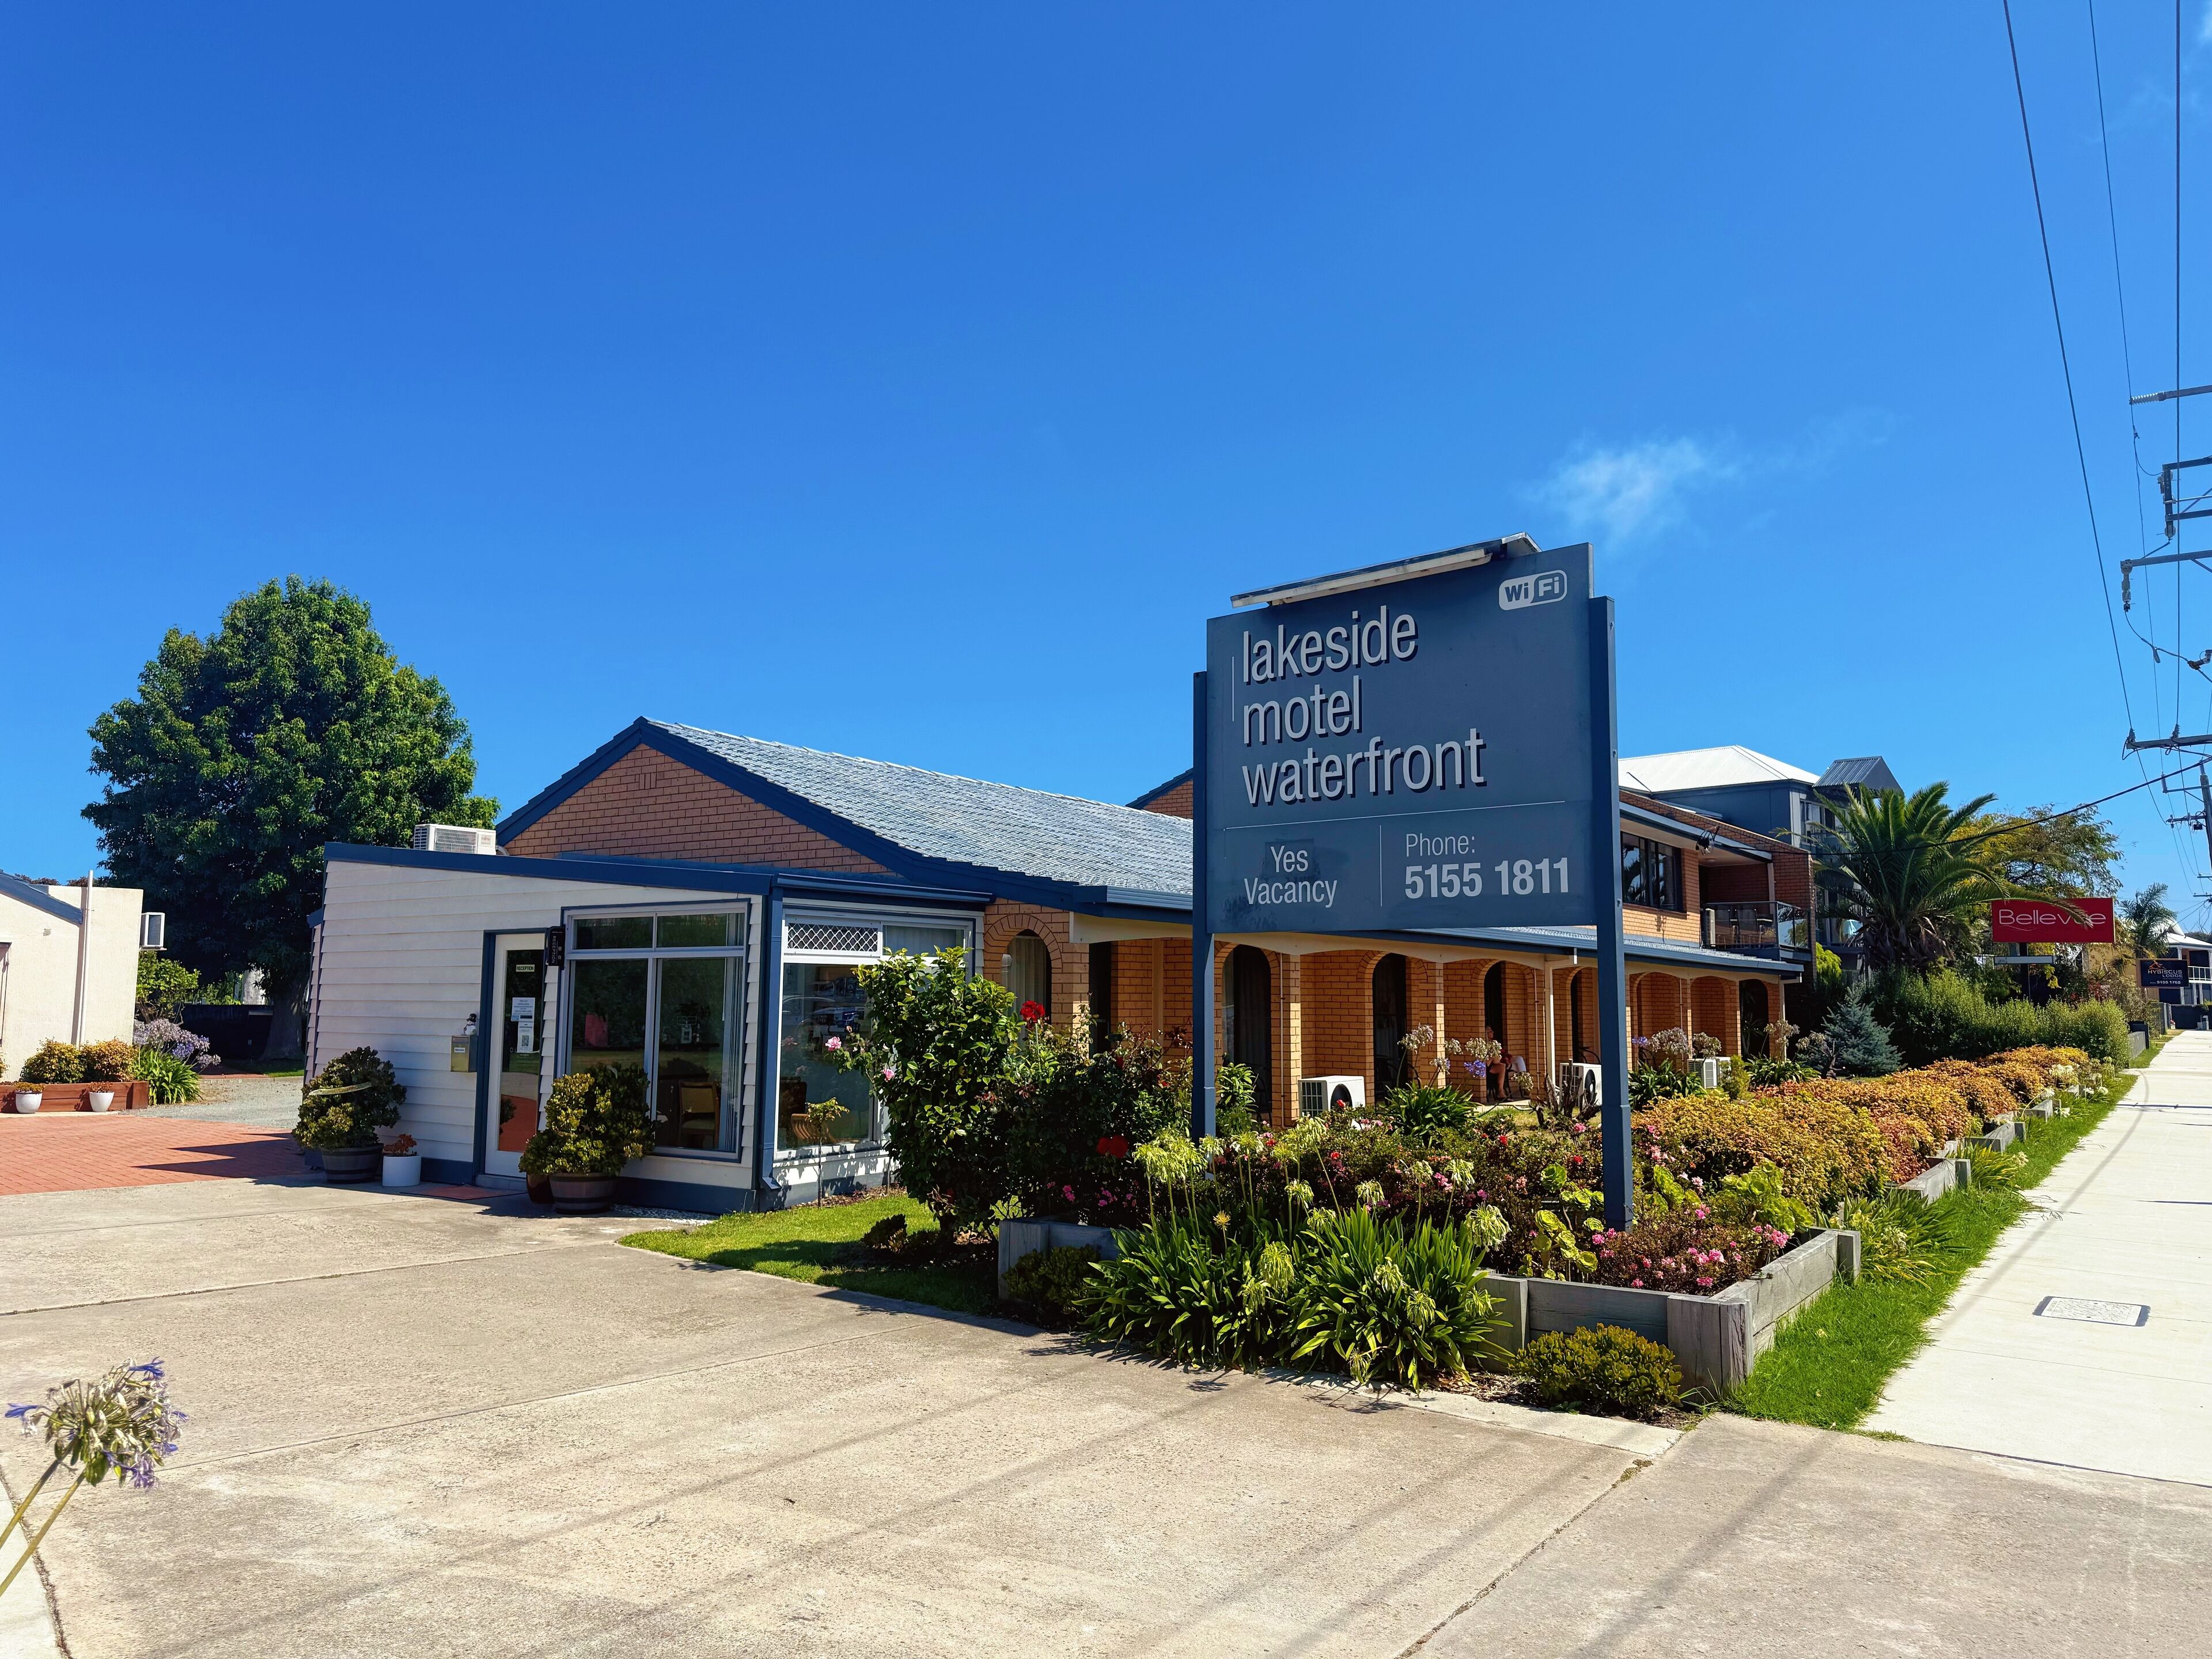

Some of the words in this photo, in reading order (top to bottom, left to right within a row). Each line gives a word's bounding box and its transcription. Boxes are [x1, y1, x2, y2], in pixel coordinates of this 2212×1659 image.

[1243, 605, 1418, 684] lakeside
[1243, 676, 1362, 745] motel
[1241, 728, 1486, 806] waterfront
[1270, 845, 1308, 873] Yes
[1405, 833, 1476, 858] Phone:
[1244, 878, 1338, 908] Vacancy
[1404, 862, 1483, 900] 5155
[1494, 857, 1569, 896] 1811
